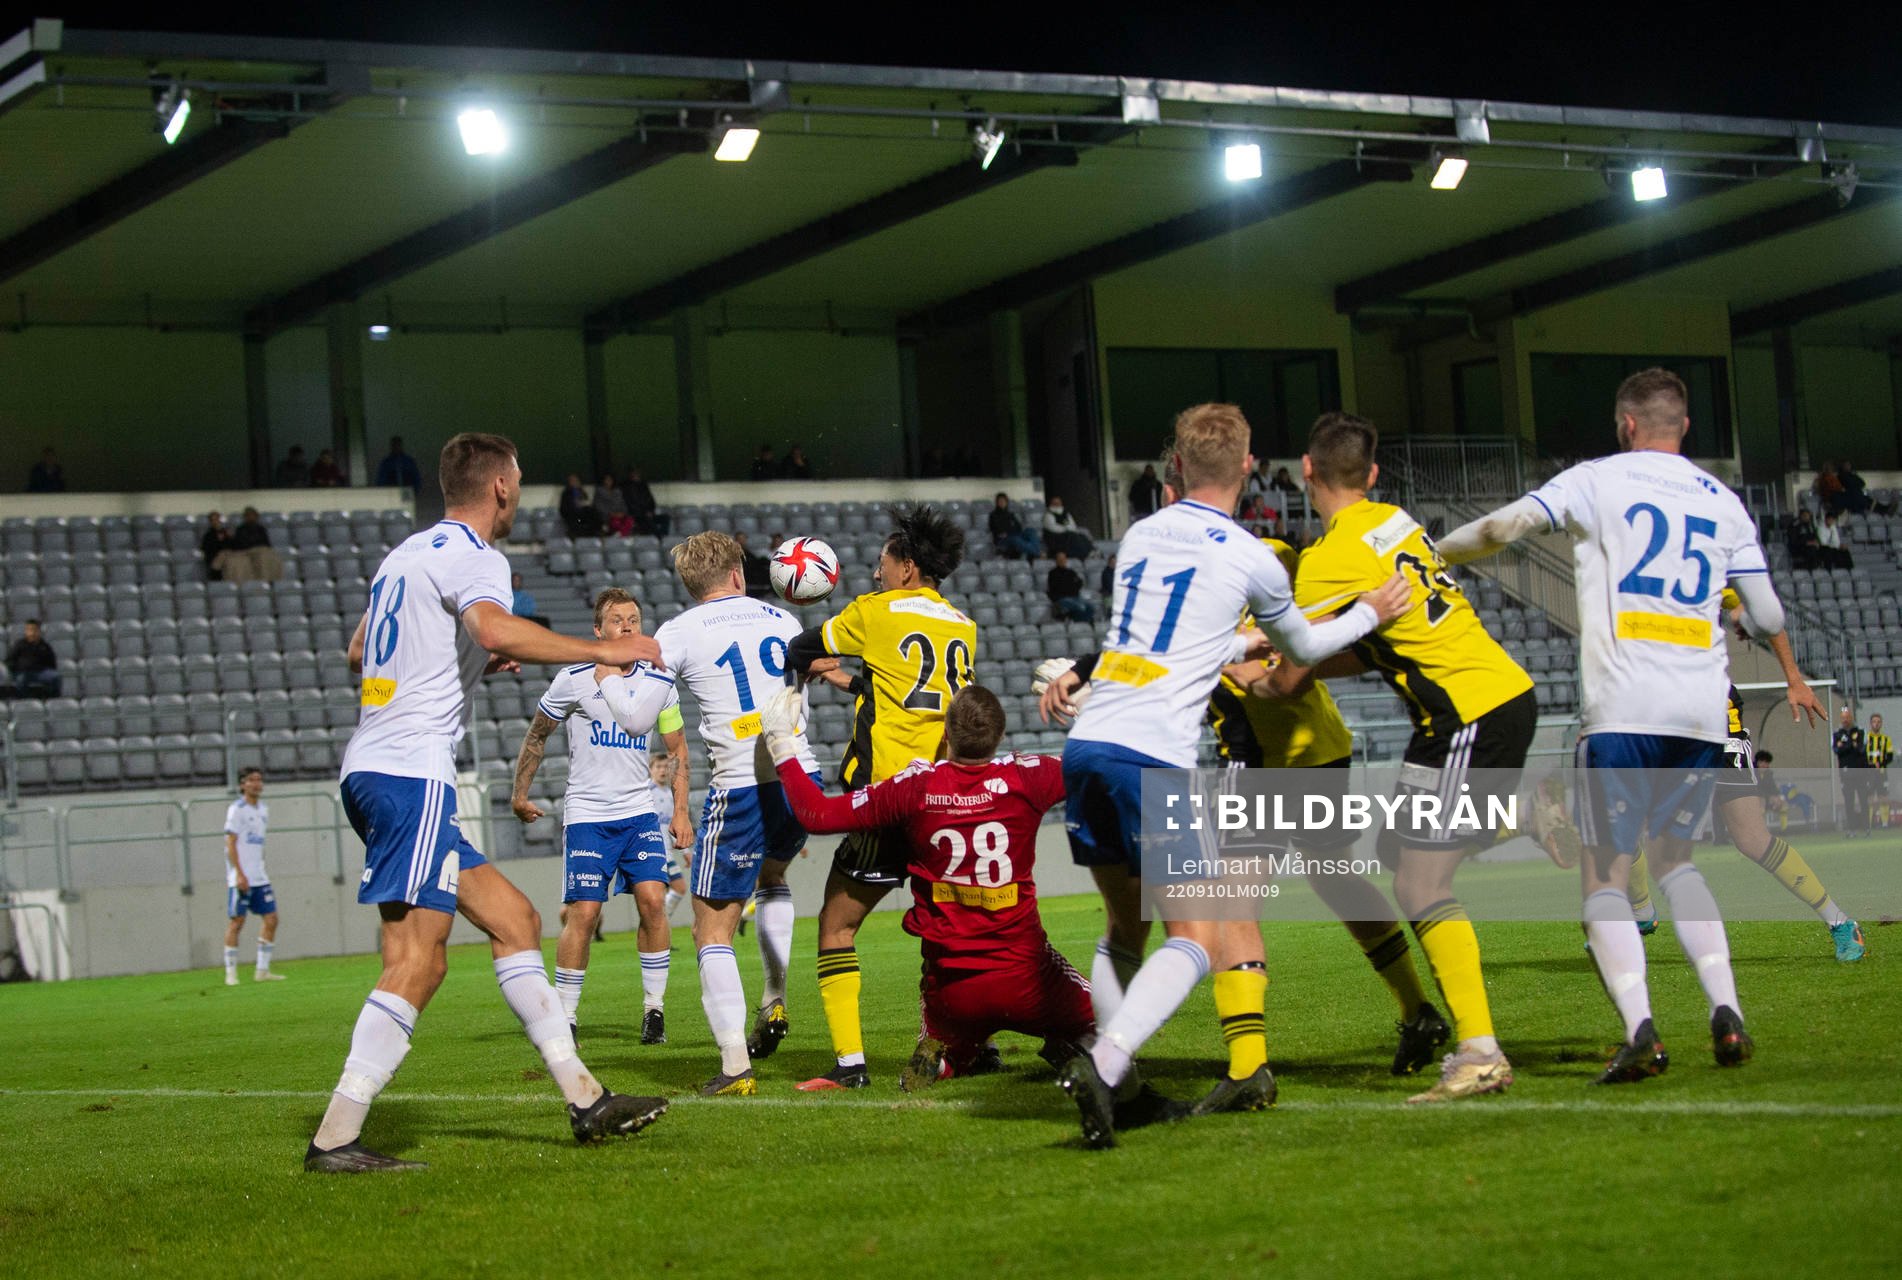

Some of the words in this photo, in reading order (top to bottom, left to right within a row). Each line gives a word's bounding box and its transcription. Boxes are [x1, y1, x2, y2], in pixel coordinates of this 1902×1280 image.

[1618, 502, 1717, 605] 25
[363, 574, 406, 667] 18
[1117, 557, 1196, 655] 11
[925, 793, 952, 806] FRITID
[952, 792, 993, 807] ÖSTERLEN
[930, 821, 1013, 888] 28
